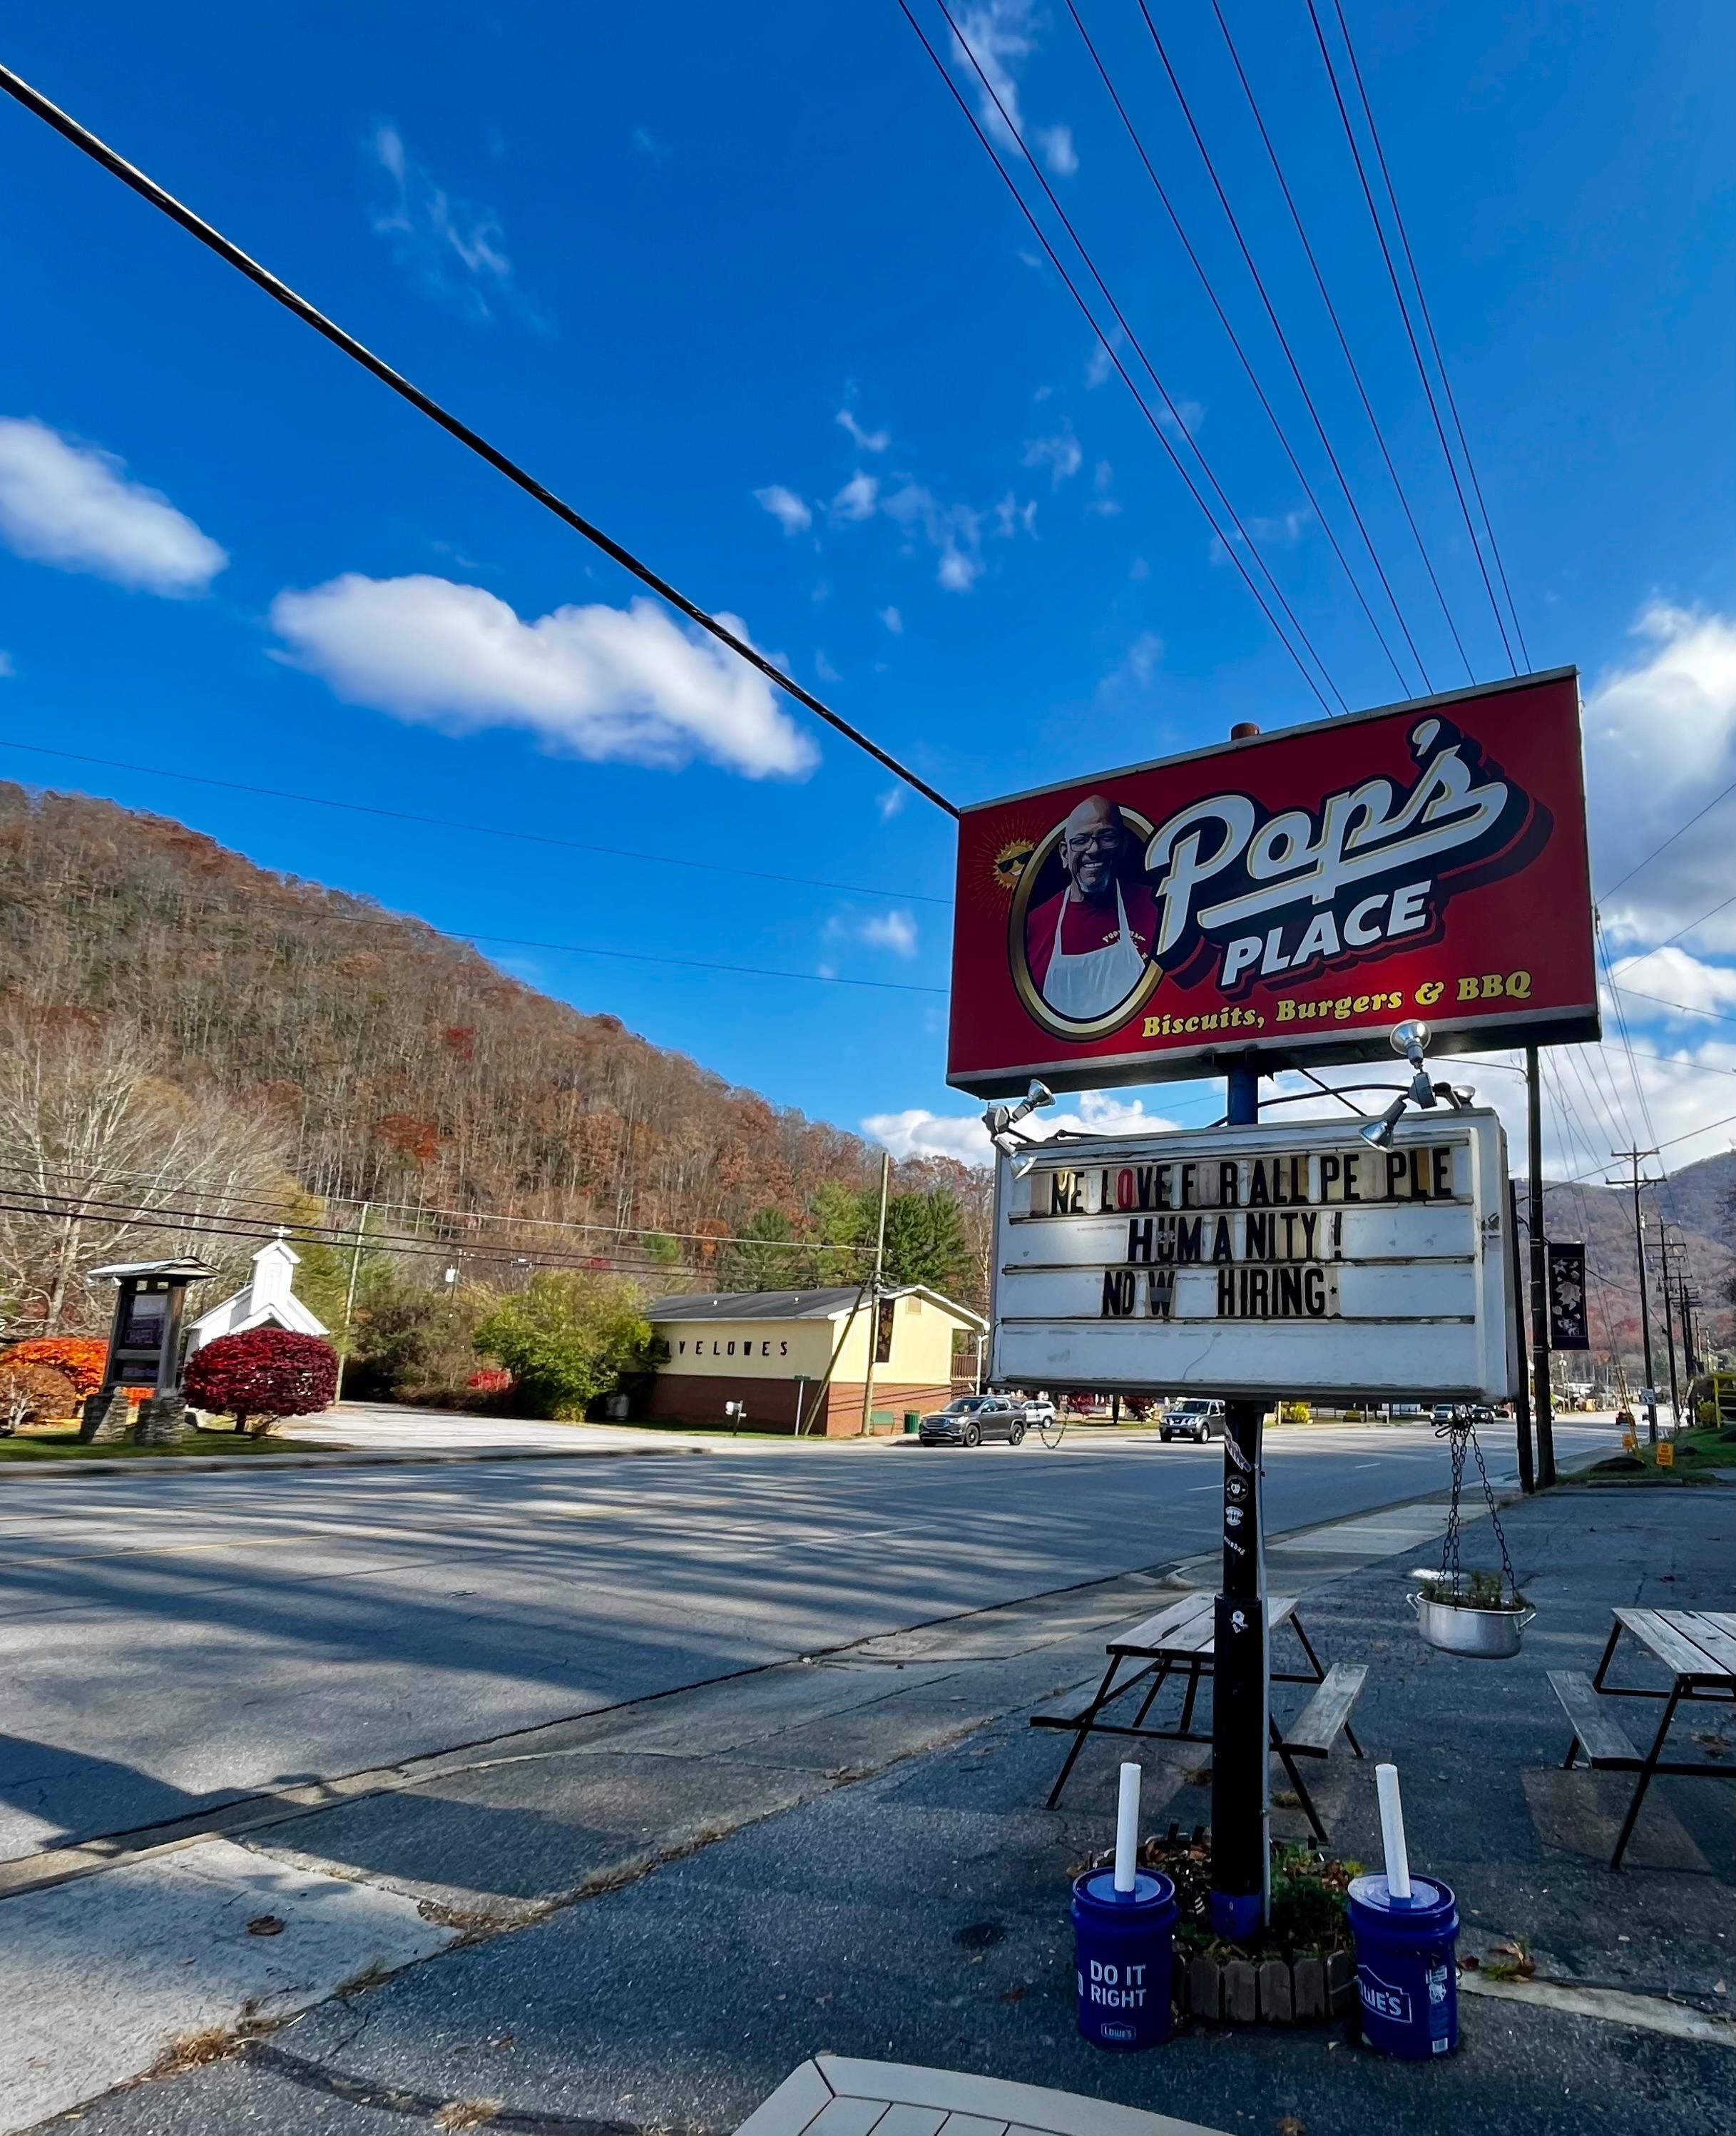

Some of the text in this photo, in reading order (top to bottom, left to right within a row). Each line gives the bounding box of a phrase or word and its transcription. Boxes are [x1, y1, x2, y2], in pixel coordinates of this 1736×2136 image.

[1145, 718, 1508, 956] Pop's
[1221, 880, 1431, 986] PLACE
[1142, 970, 1532, 1037] Biscuits, Burgers & BBQ
[1101, 1164, 1171, 1211] LOVE
[1249, 1156, 1307, 1206] ALL
[1091, 1959, 1146, 1986] DO IT
[1091, 1983, 1147, 2008] RIGHT
[1358, 1979, 1401, 2016] WE'S
